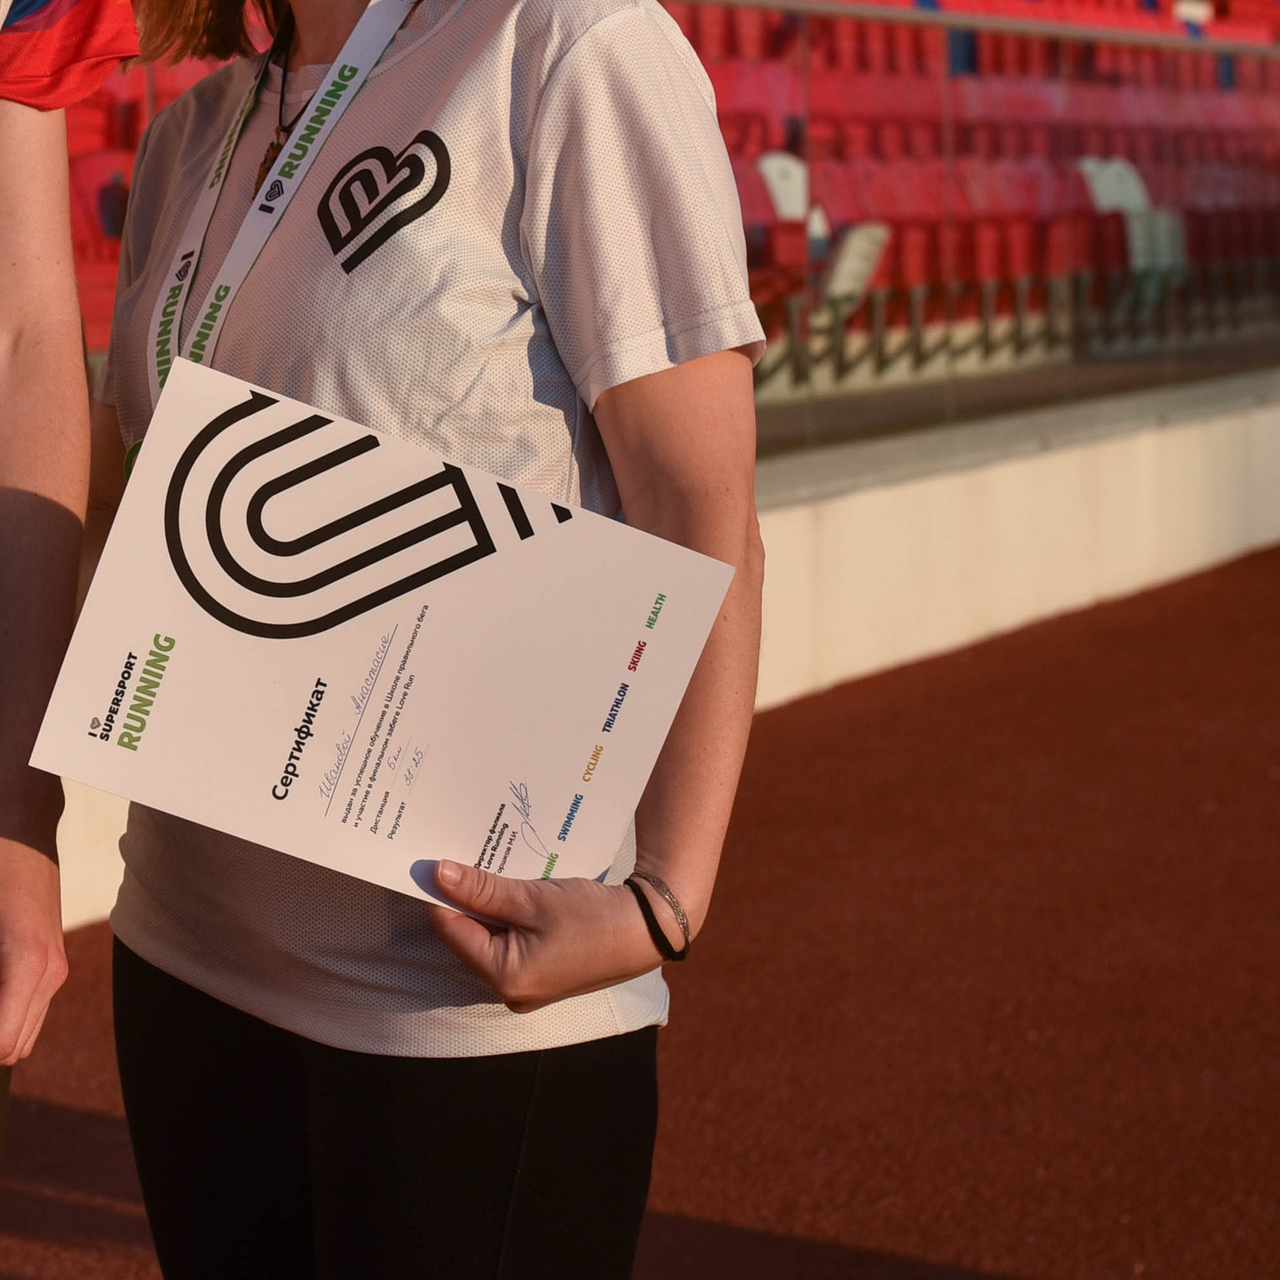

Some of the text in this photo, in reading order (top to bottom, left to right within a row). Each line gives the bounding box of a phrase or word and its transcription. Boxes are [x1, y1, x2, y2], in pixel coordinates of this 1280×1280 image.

[277, 64, 360, 180] RUNNING
[644, 593, 667, 631] HEALTH
[627, 640, 648, 673] SKIING
[98, 651, 138, 742] SUPERSPORT
[116, 633, 176, 752] RUNNING
[342, 798, 354, 824] выдан
[350, 788, 359, 798] за
[355, 748, 373, 787] успешное
[369, 709, 387, 747] обучение
[385, 675, 401, 702] Школе
[397, 623, 421, 674] правильного
[417, 604, 429, 623] бега
[601, 682, 630, 733] TRIATHLON
[271, 677, 328, 801] Сертификат
[356, 790, 371, 821] участие
[369, 738, 389, 782] финальном
[386, 710, 401, 737] забеге
[395, 691, 408, 710] Love
[403, 674, 415, 690] Run
[582, 744, 604, 784] CYCLING
[369, 791, 390, 835] Дистанция
[387, 801, 406, 840] Результат
[474, 803, 506, 870] Директор филиала
[557, 793, 584, 842] SWIMMING
[483, 823, 509, 870] Love Running
[494, 846, 512, 875] оршков
[540, 852, 559, 881] NNING
